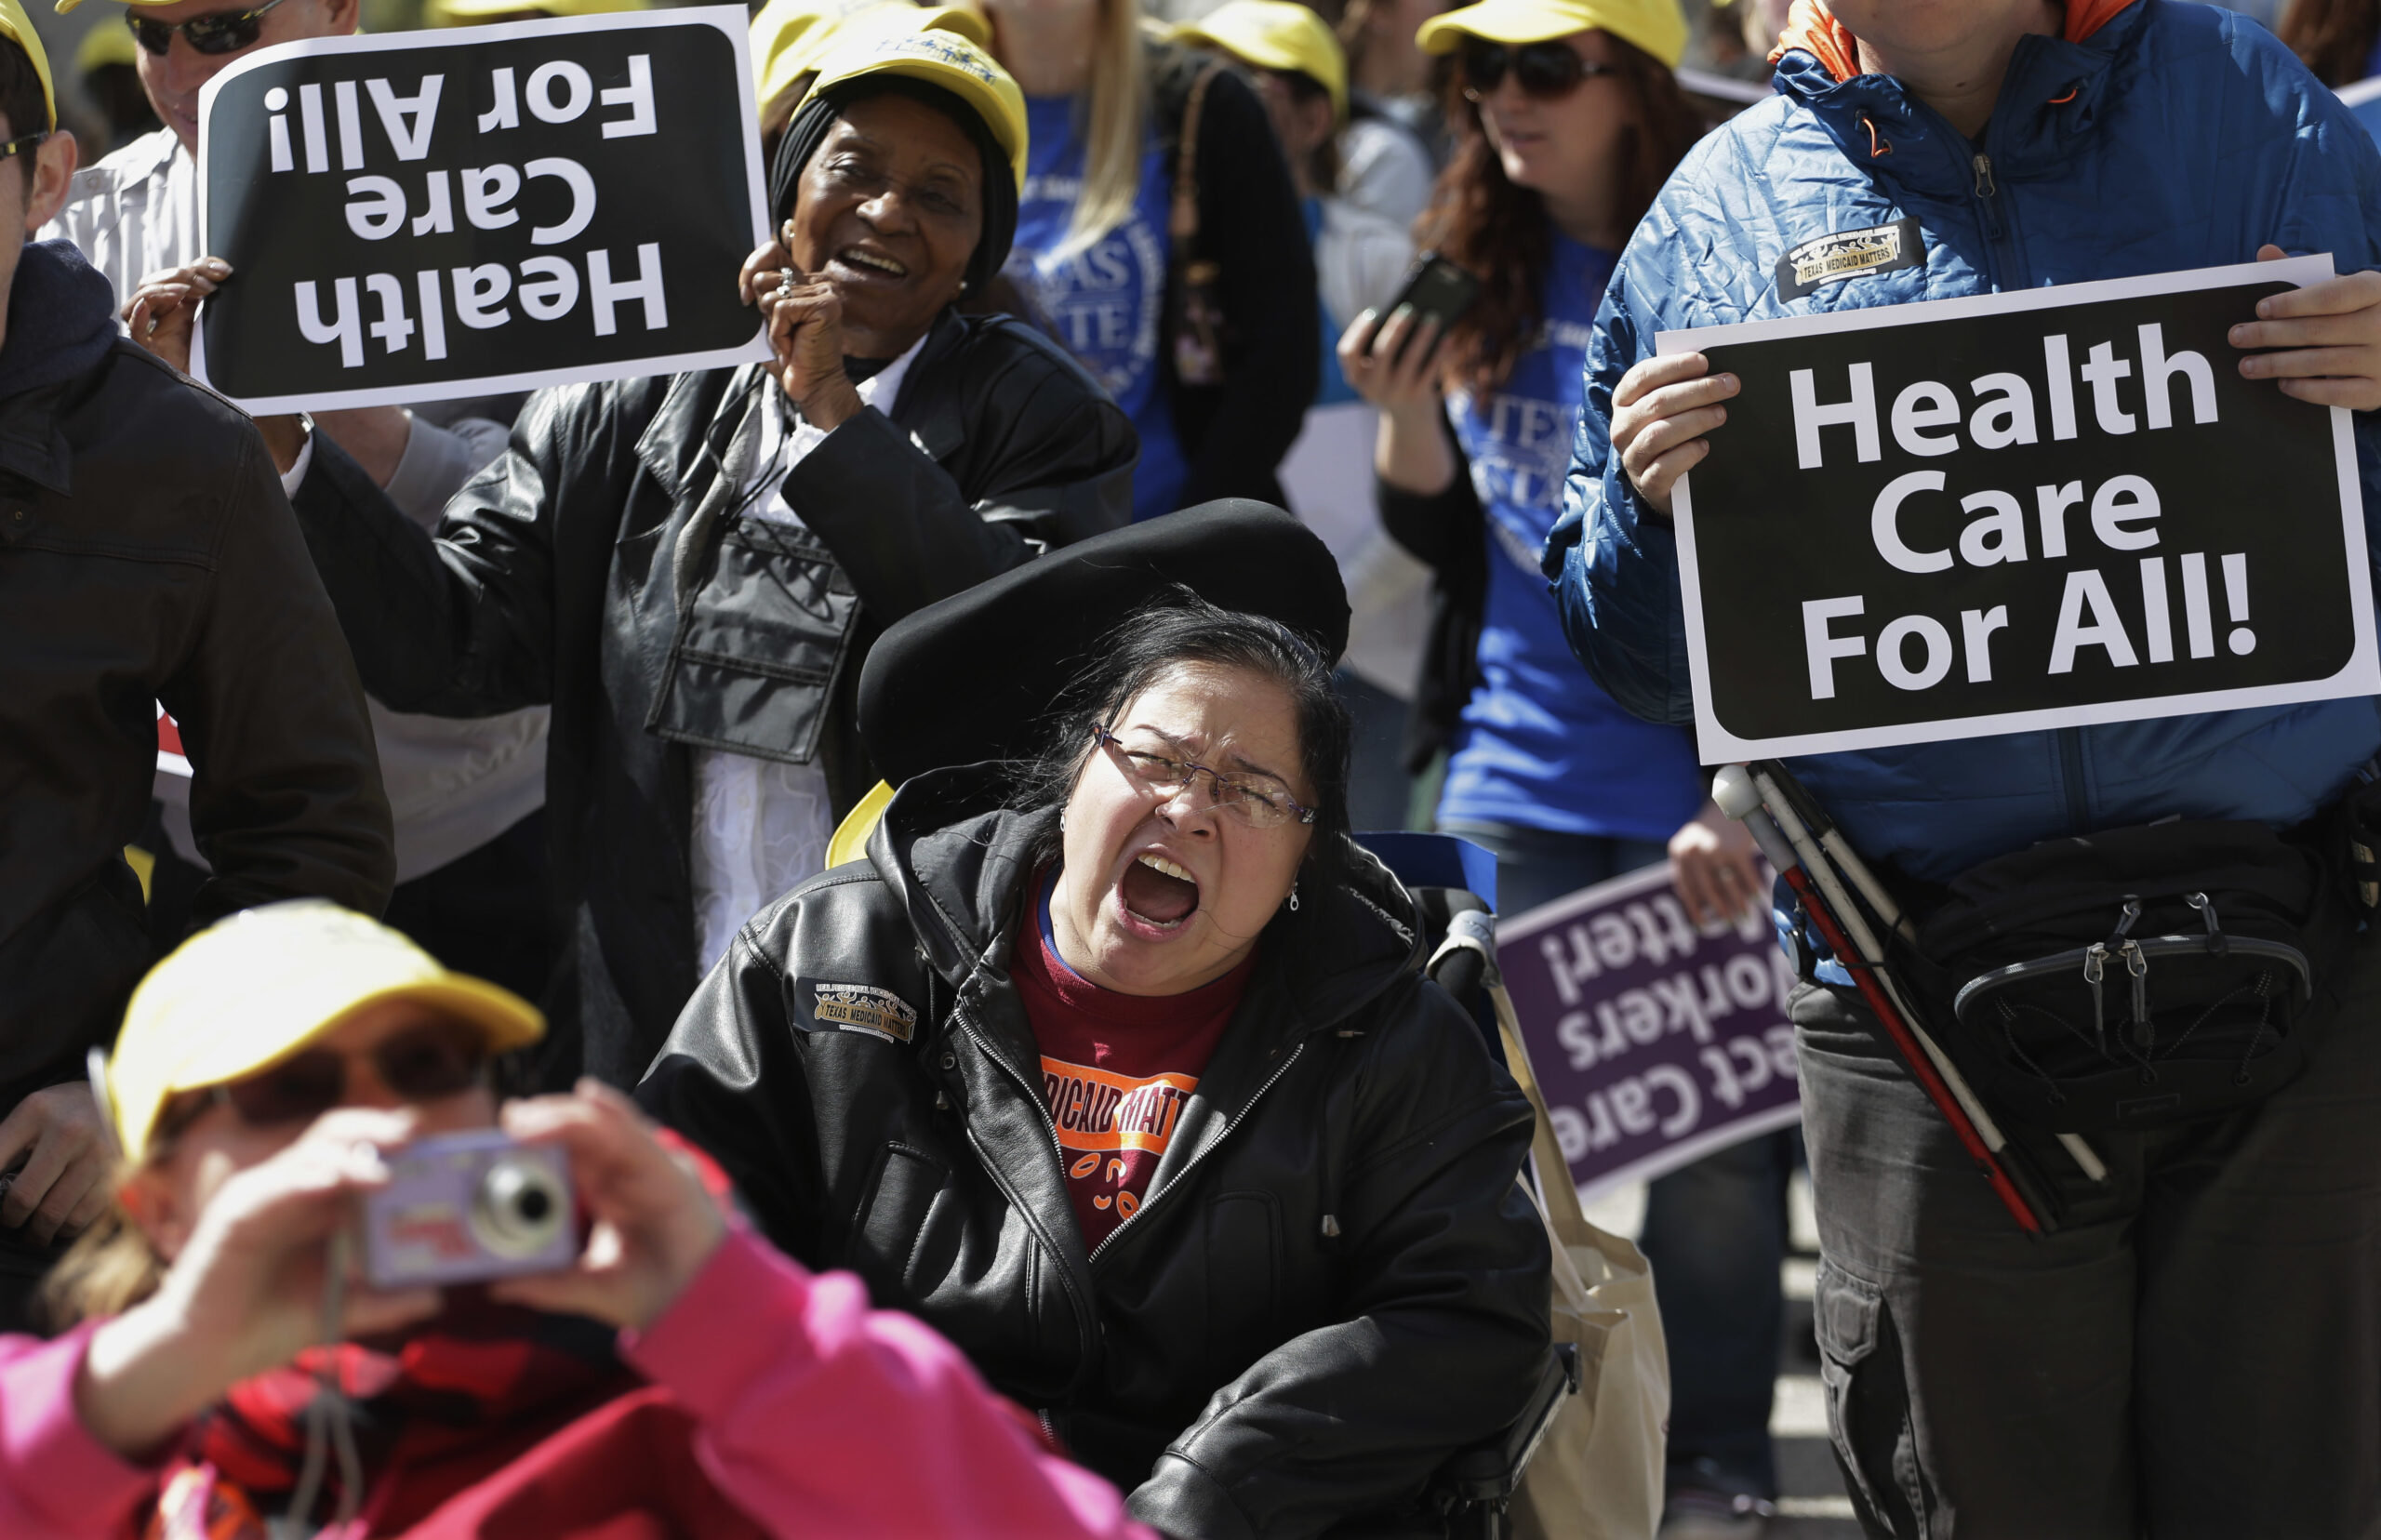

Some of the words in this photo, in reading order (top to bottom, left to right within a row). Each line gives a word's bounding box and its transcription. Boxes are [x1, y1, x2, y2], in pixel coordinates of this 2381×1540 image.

[263, 73, 445, 174] All!
[477, 53, 658, 139] For
[345, 156, 596, 246] Care
[294, 242, 668, 368] Health
[1803, 262, 1823, 280] TEXAS
[1826, 256, 1858, 272] MEDICAID
[1859, 246, 1891, 265] MATTERS
[1789, 322, 2219, 470] Health
[1870, 470, 2162, 574] Care
[1802, 594, 2009, 700] For
[2047, 551, 2256, 674] All!
[825, 1003, 847, 1020] TEXAS
[849, 1008, 882, 1026] MEDICAID
[884, 1015, 907, 1039] MATTERS
[1043, 1070, 1124, 1134] DICAID
[1550, 1064, 1702, 1162] Care
